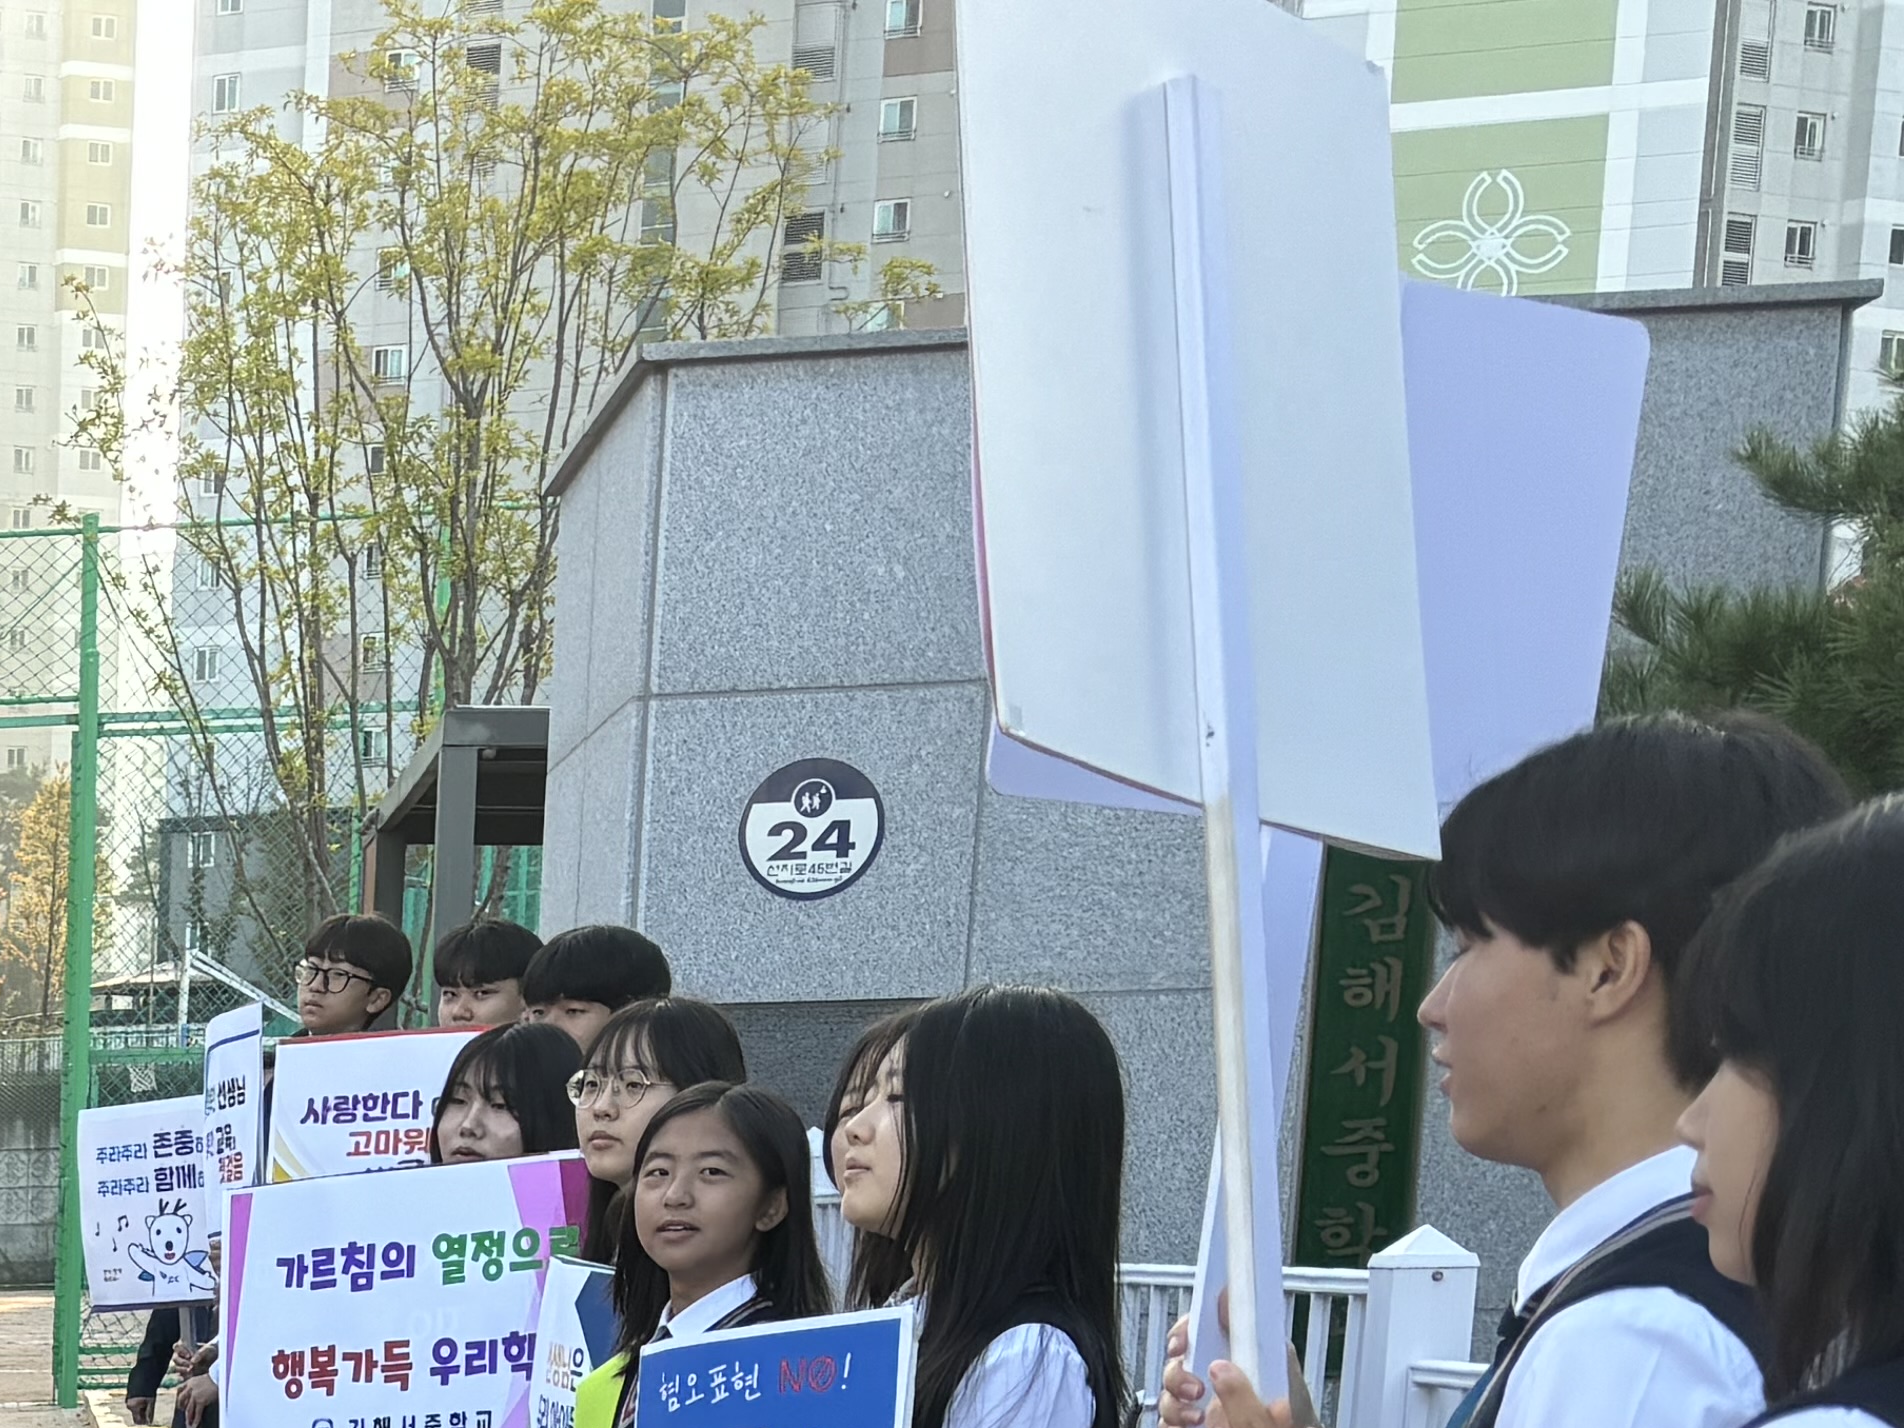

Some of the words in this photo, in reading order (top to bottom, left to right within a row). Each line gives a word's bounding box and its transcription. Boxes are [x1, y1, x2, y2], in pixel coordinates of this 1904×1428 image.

[766, 819, 856, 861] 24
[1313, 874, 1412, 1267] 김해서중학
[217, 1074, 245, 1110] 선생님
[299, 1090, 423, 1125] 사랑한다
[346, 1127, 430, 1157] 고마워
[276, 1240, 416, 1292] 가르침의
[271, 1338, 414, 1399] 행복가득
[429, 1330, 537, 1386] 우리학
[778, 1352, 853, 1394] NO!
